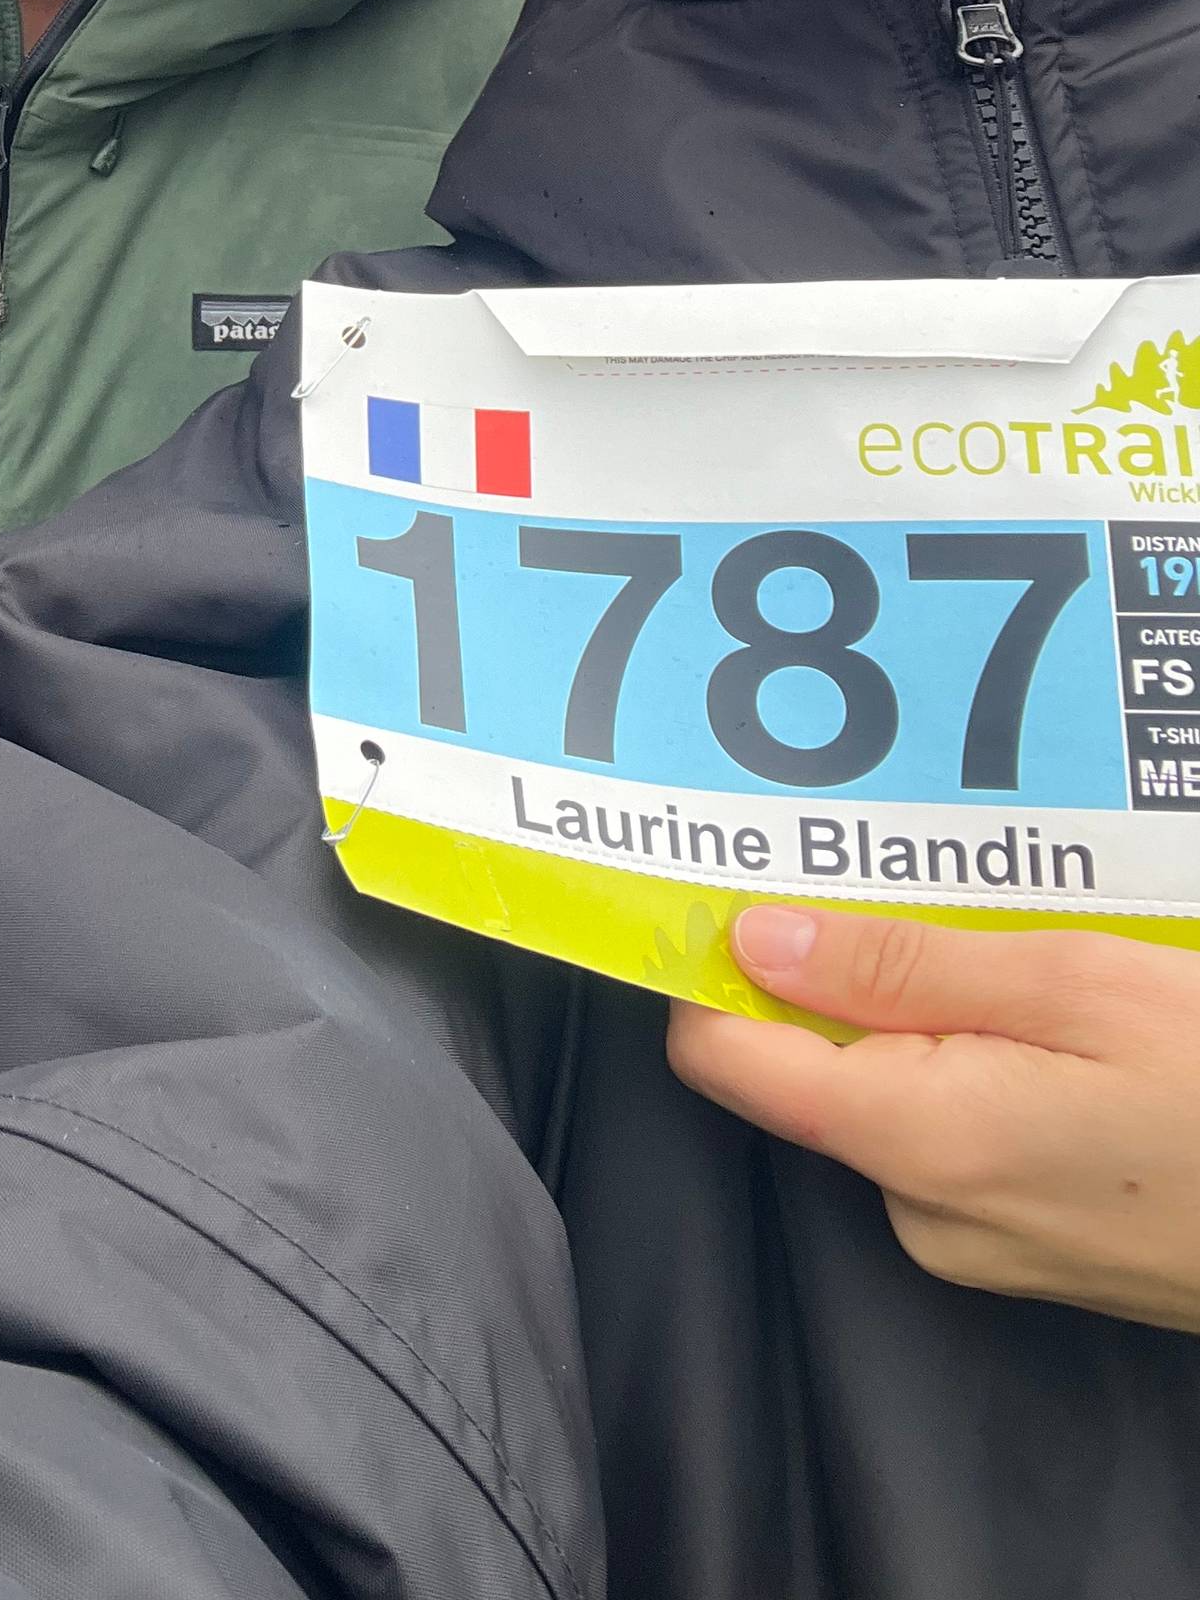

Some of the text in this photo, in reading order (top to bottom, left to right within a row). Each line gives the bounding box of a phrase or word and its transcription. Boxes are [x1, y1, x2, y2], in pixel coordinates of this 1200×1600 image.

[1131, 536, 1200, 552] DISTAN
[1140, 556, 1200, 596] 19
[355, 510, 1091, 791] 1787
[1132, 659, 1195, 696] FS
[511, 775, 1096, 890] Laurine Blandin
